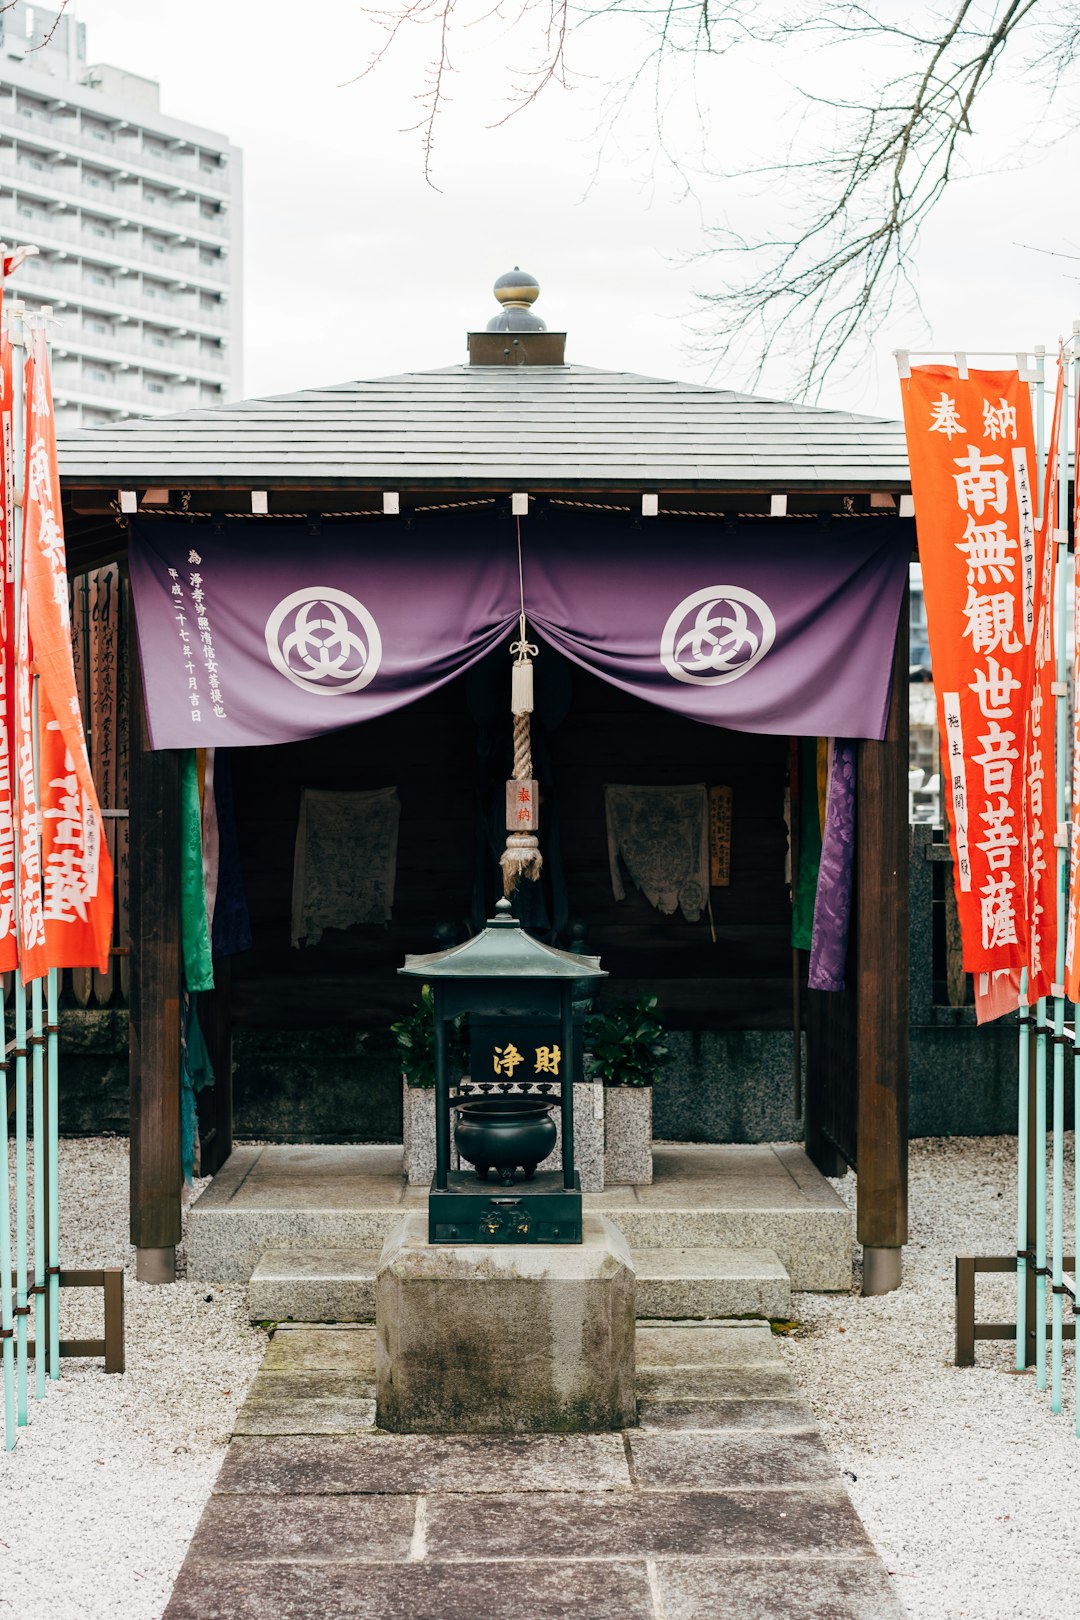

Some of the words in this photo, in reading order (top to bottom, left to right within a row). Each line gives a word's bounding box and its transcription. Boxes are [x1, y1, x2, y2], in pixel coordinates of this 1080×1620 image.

[928, 392, 1017, 441] 奉納
[167, 568, 201, 722] 平成二十七年十月吉日
[952, 444, 1023, 950] 南無観世音菩薩
[517, 787, 531, 822] 奉納
